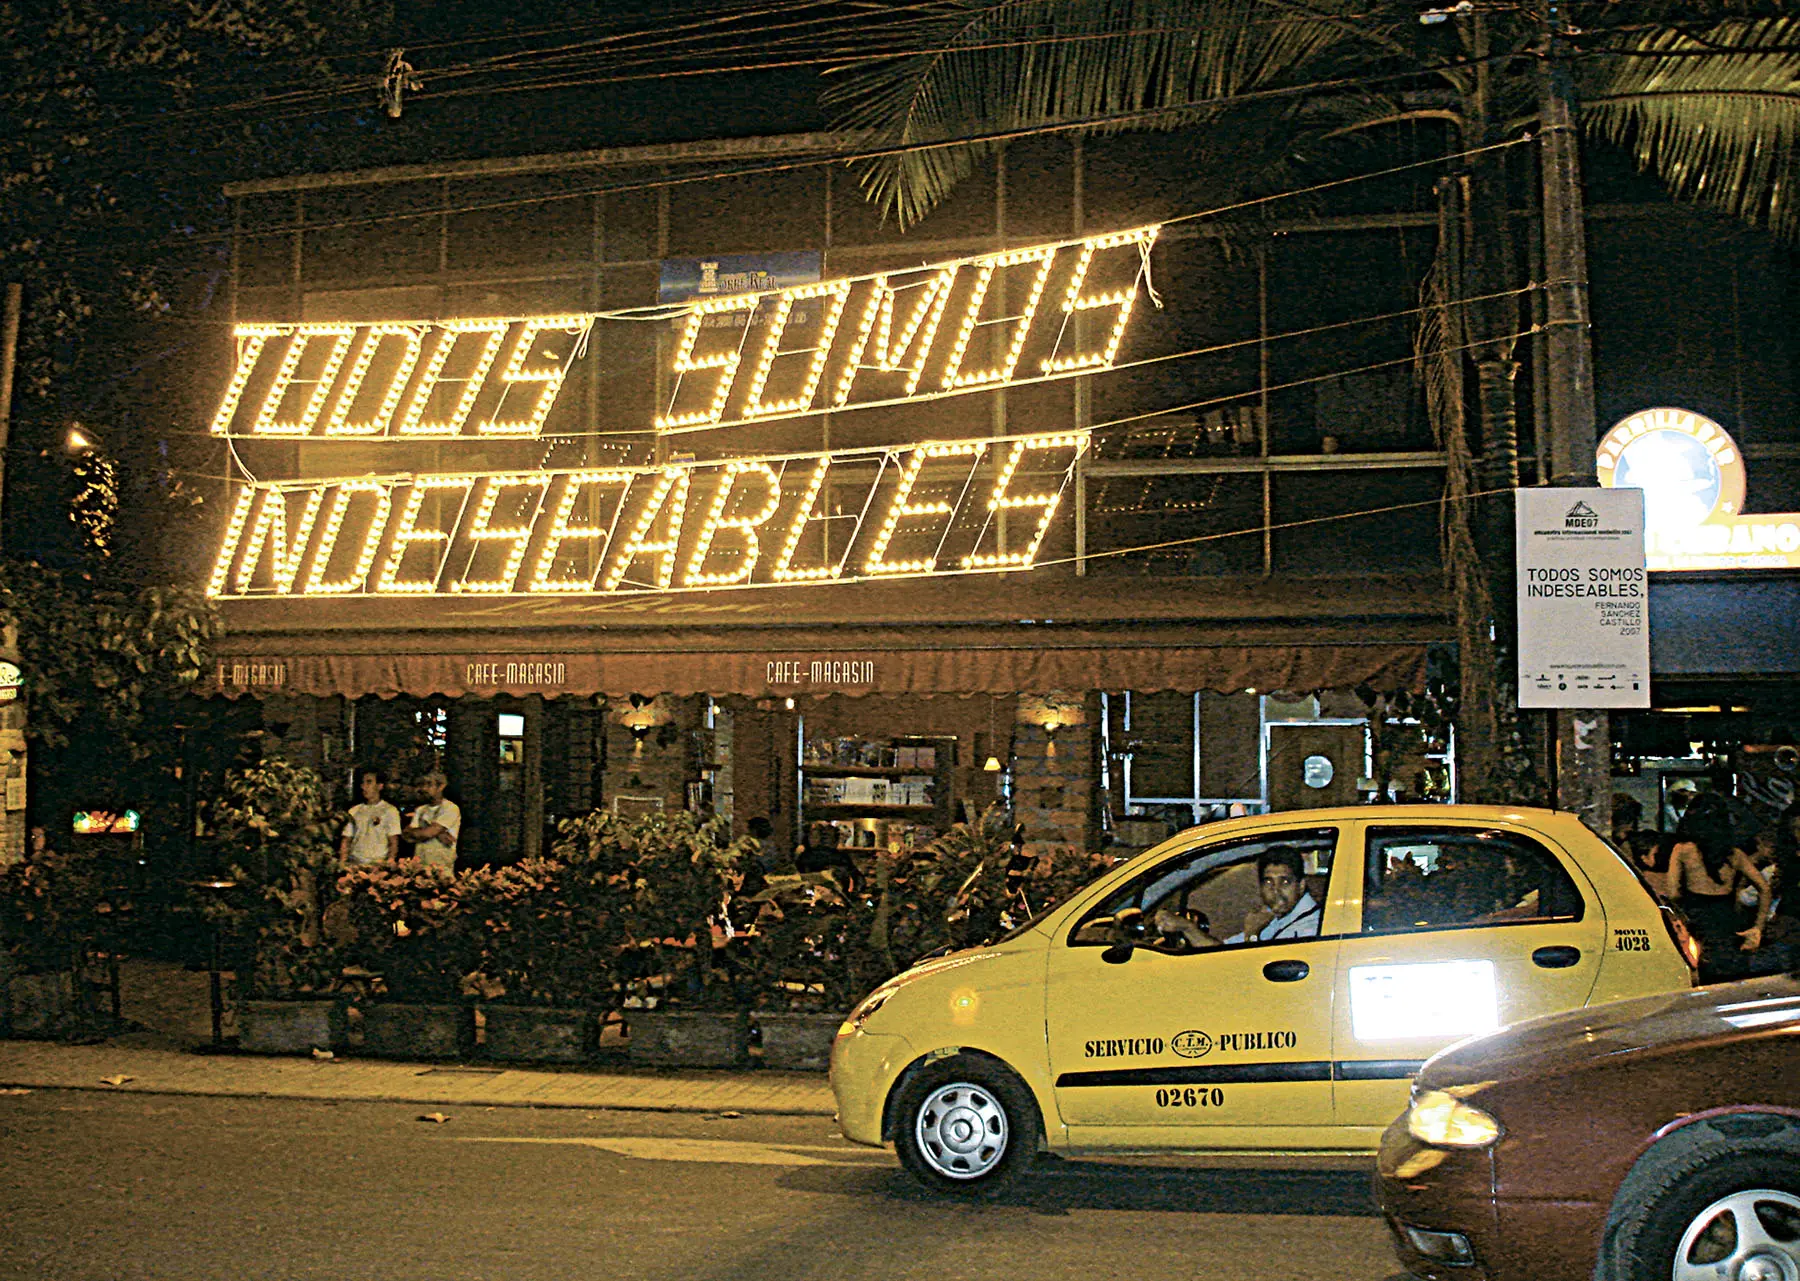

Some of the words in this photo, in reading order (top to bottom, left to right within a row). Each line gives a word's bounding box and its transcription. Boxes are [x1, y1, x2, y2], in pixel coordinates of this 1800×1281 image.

[210, 319, 594, 438] TODOS
[655, 226, 1158, 431] SOMOS
[1597, 410, 1696, 469] PARRILLA
[1695, 423, 1736, 466] BAR
[207, 432, 1088, 600] INDESEABLES
[1527, 568, 1580, 581] TODOS
[1588, 568, 1643, 581] SOMOS
[1528, 584, 1644, 598] INDESEABLES,
[1615, 937, 1650, 951] 4028
[1084, 1037, 1164, 1058] SERVICIO
[1219, 1031, 1297, 1051] PUBLICO
[1155, 1087, 1225, 1107] 02670
